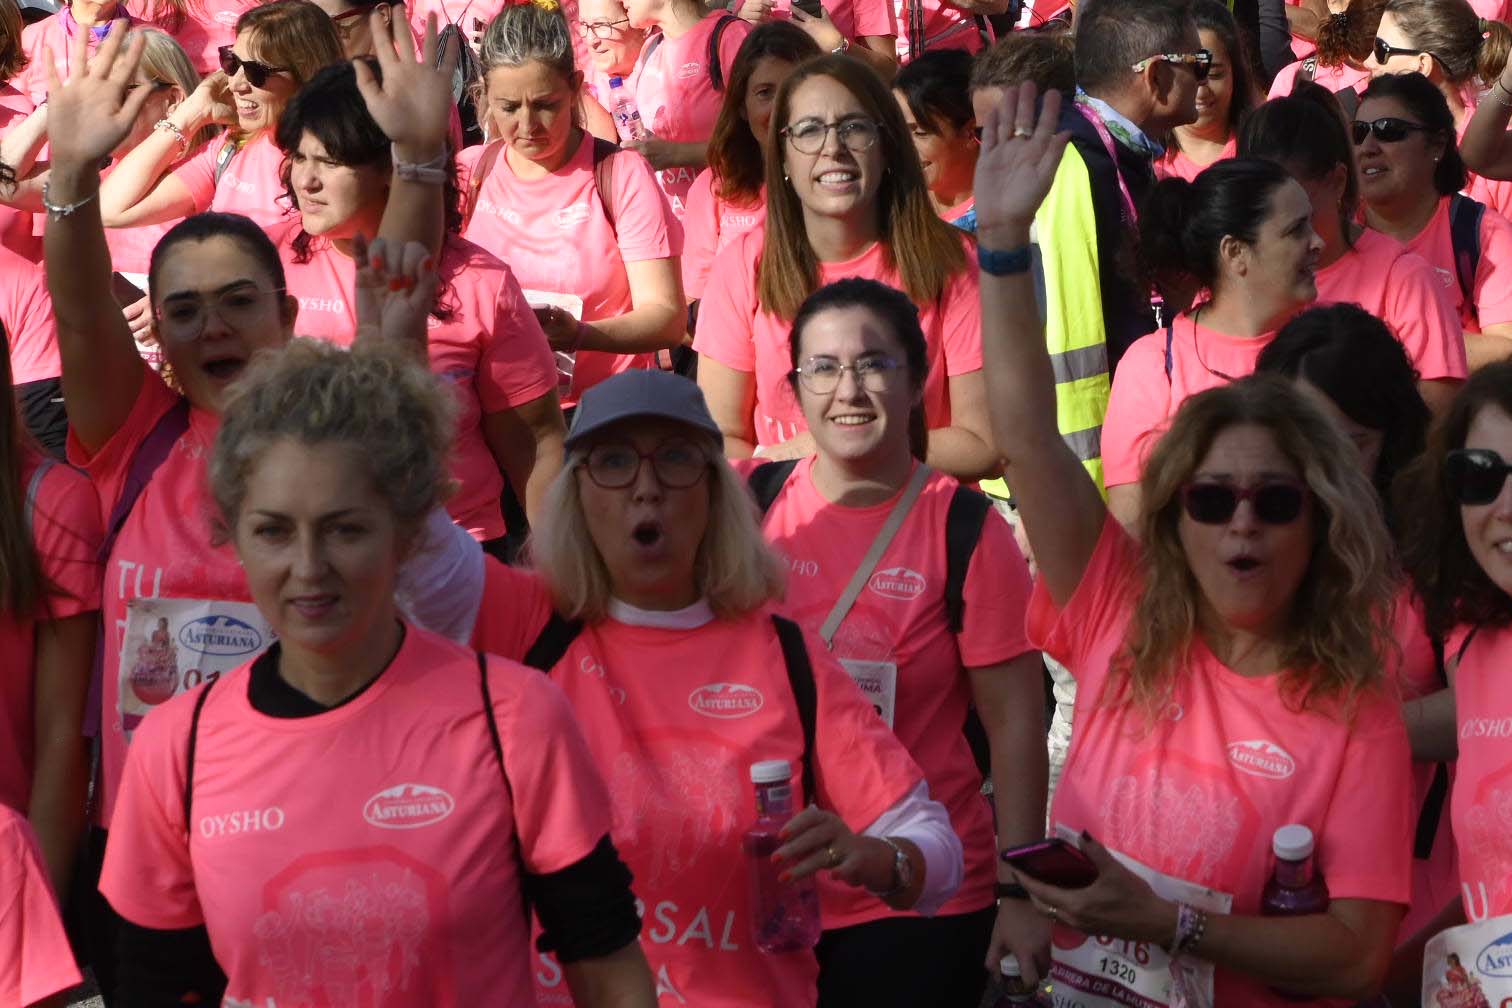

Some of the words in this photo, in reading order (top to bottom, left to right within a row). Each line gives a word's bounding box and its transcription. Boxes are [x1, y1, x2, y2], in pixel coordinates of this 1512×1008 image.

[186, 628, 256, 648] ASTURIANA
[696, 694, 758, 710] ASTURIANA
[1229, 748, 1290, 775] ASTURIANA
[200, 806, 285, 839] OYSHO
[371, 802, 448, 821] ASTURIANA
[1099, 957, 1137, 985] 1320
